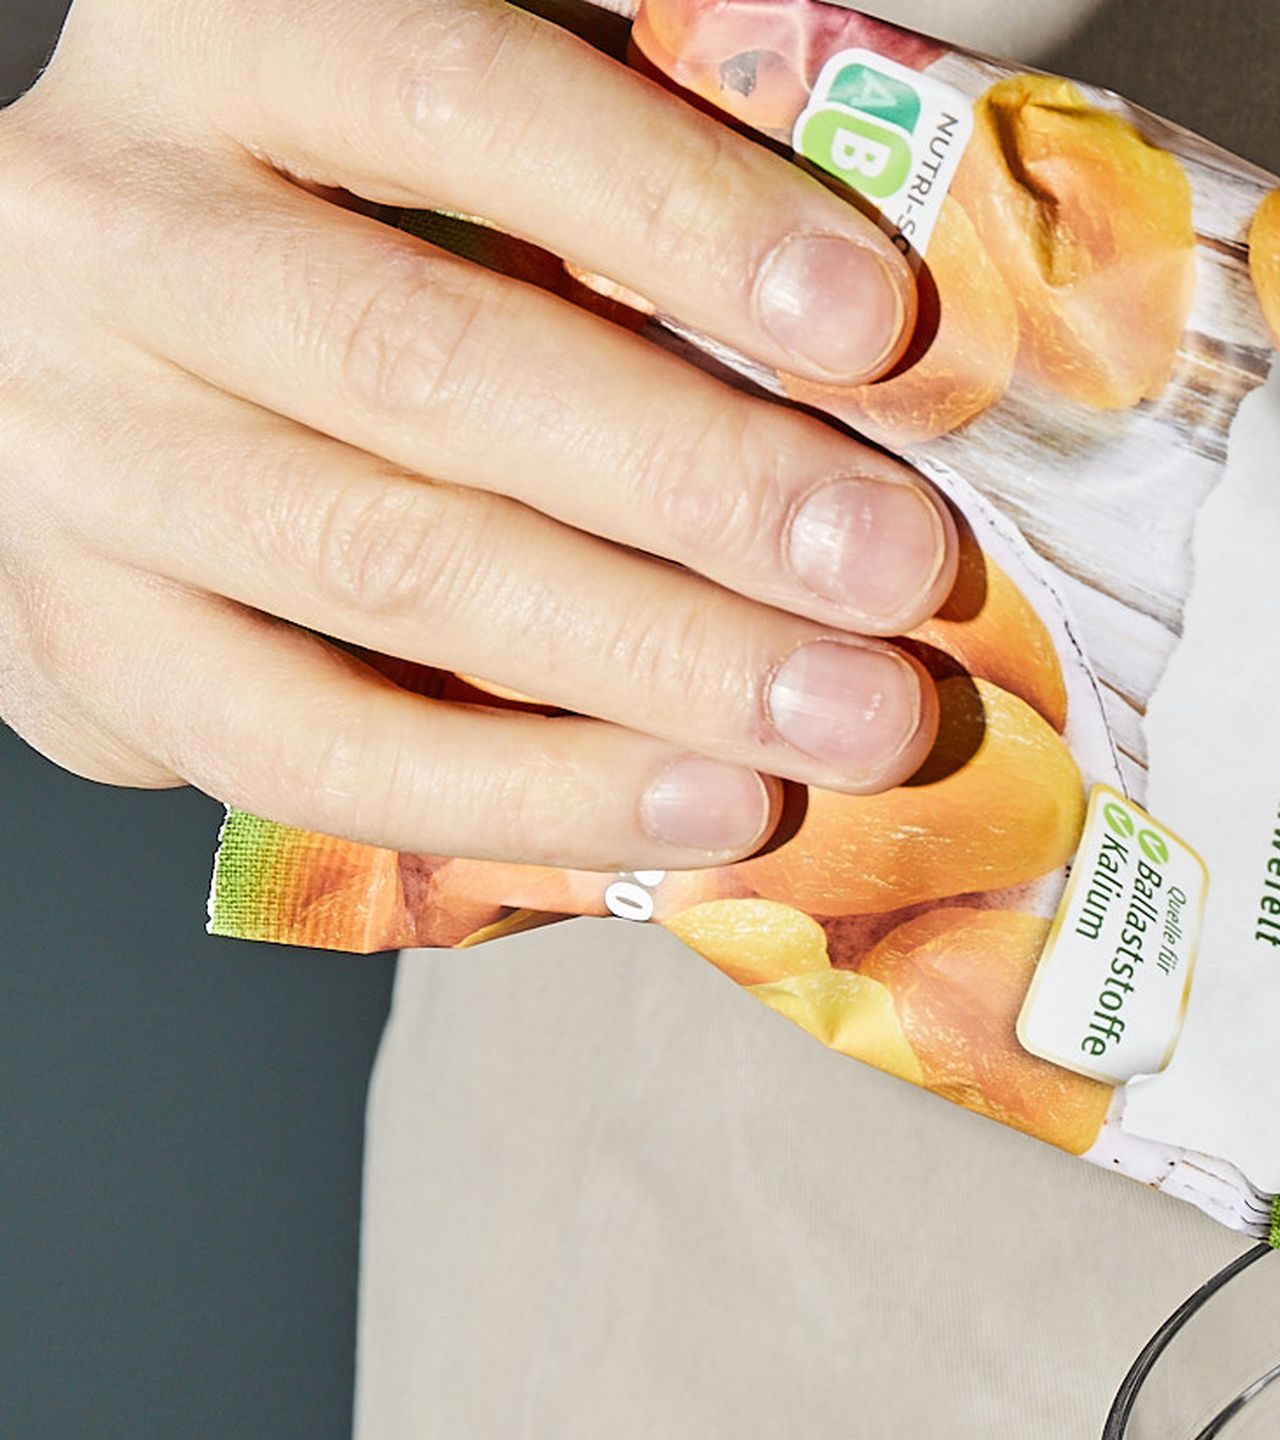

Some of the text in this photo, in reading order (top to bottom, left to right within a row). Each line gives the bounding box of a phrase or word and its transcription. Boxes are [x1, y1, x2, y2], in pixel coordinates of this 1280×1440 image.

[850, 68, 898, 108] A
[829, 127, 892, 179] B
[890, 112, 960, 257] NUTRI-SC
[1075, 833, 1129, 940] Kalium
[1156, 886, 1187, 976] Quelle für
[1081, 859, 1163, 1056] Ballaststoffe
